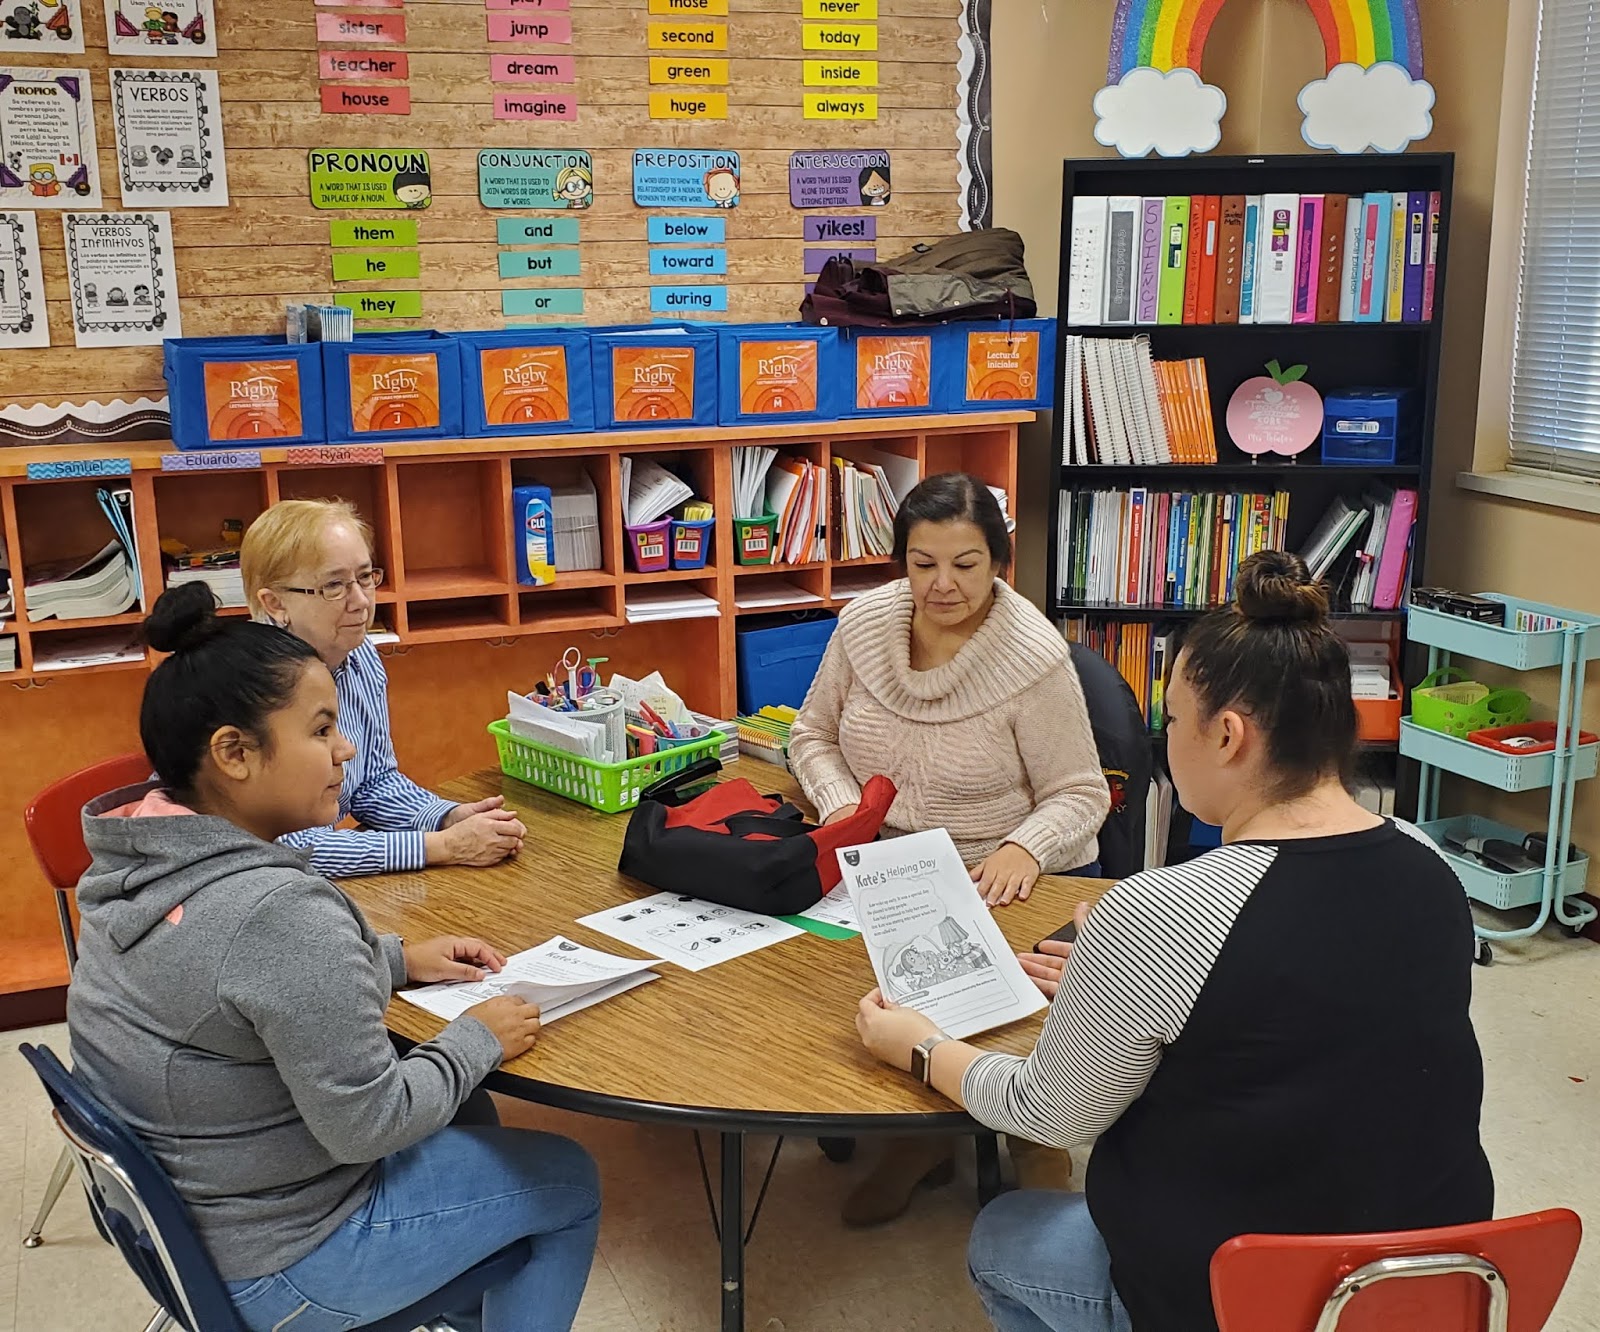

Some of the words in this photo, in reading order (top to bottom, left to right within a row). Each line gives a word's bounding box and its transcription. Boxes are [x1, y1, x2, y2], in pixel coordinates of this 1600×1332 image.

[820, 1, 860, 13] never
[339, 20, 383, 35] sister
[510, 20, 549, 38] jump
[661, 30, 714, 43] second
[819, 30, 860, 46] today
[330, 57, 396, 72] teacher
[507, 61, 559, 76] dream
[667, 66, 711, 79] green
[820, 66, 860, 80] inside
[13, 86, 58, 96] PROPIOS
[129, 87, 189, 102] VERBOS
[342, 91, 389, 106] house
[504, 98, 567, 116] imagine
[670, 98, 707, 115] huge
[816, 100, 865, 114] always
[311, 153, 427, 173] PRONOUN
[480, 153, 590, 169] CONJUNCTION
[325, 183, 345, 191] WORD
[345, 183, 362, 191] THAT
[371, 183, 388, 191] USED
[485, 188, 500, 196] JOIN
[500, 188, 520, 196] WORDS
[528, 188, 550, 196] GROUPS
[801, 187, 817, 195] ALONE
[331, 194, 350, 203] PLACE
[801, 197, 822, 206] STRONG
[91, 227, 132, 237] VERBOS
[353, 225, 394, 240] them
[524, 223, 553, 237] and
[664, 222, 708, 236] below
[816, 219, 865, 240] yikes!
[366, 258, 386, 272] he
[527, 256, 552, 270] but
[662, 254, 714, 268] toward
[1141, 204, 1159, 320] SCIENCE
[361, 298, 396, 313] they
[535, 297, 552, 308] or
[666, 291, 712, 306] during
[986, 351, 1020, 359] Lecturas
[758, 358, 798, 378] Rigby
[874, 354, 913, 373] Rigby
[986, 360, 1019, 369] iniciales
[371, 372, 418, 393] Rigby
[503, 366, 547, 387] Rigby
[633, 366, 676, 387] Rigby
[229, 380, 278, 401] Rigby
[185, 454, 238, 467] Eduardo
[319, 448, 351, 461] Ryan
[54, 461, 104, 475] Samuel
[855, 871, 887, 888] Kate's
[886, 864, 918, 877] Helping
[918, 858, 936, 870] Day
